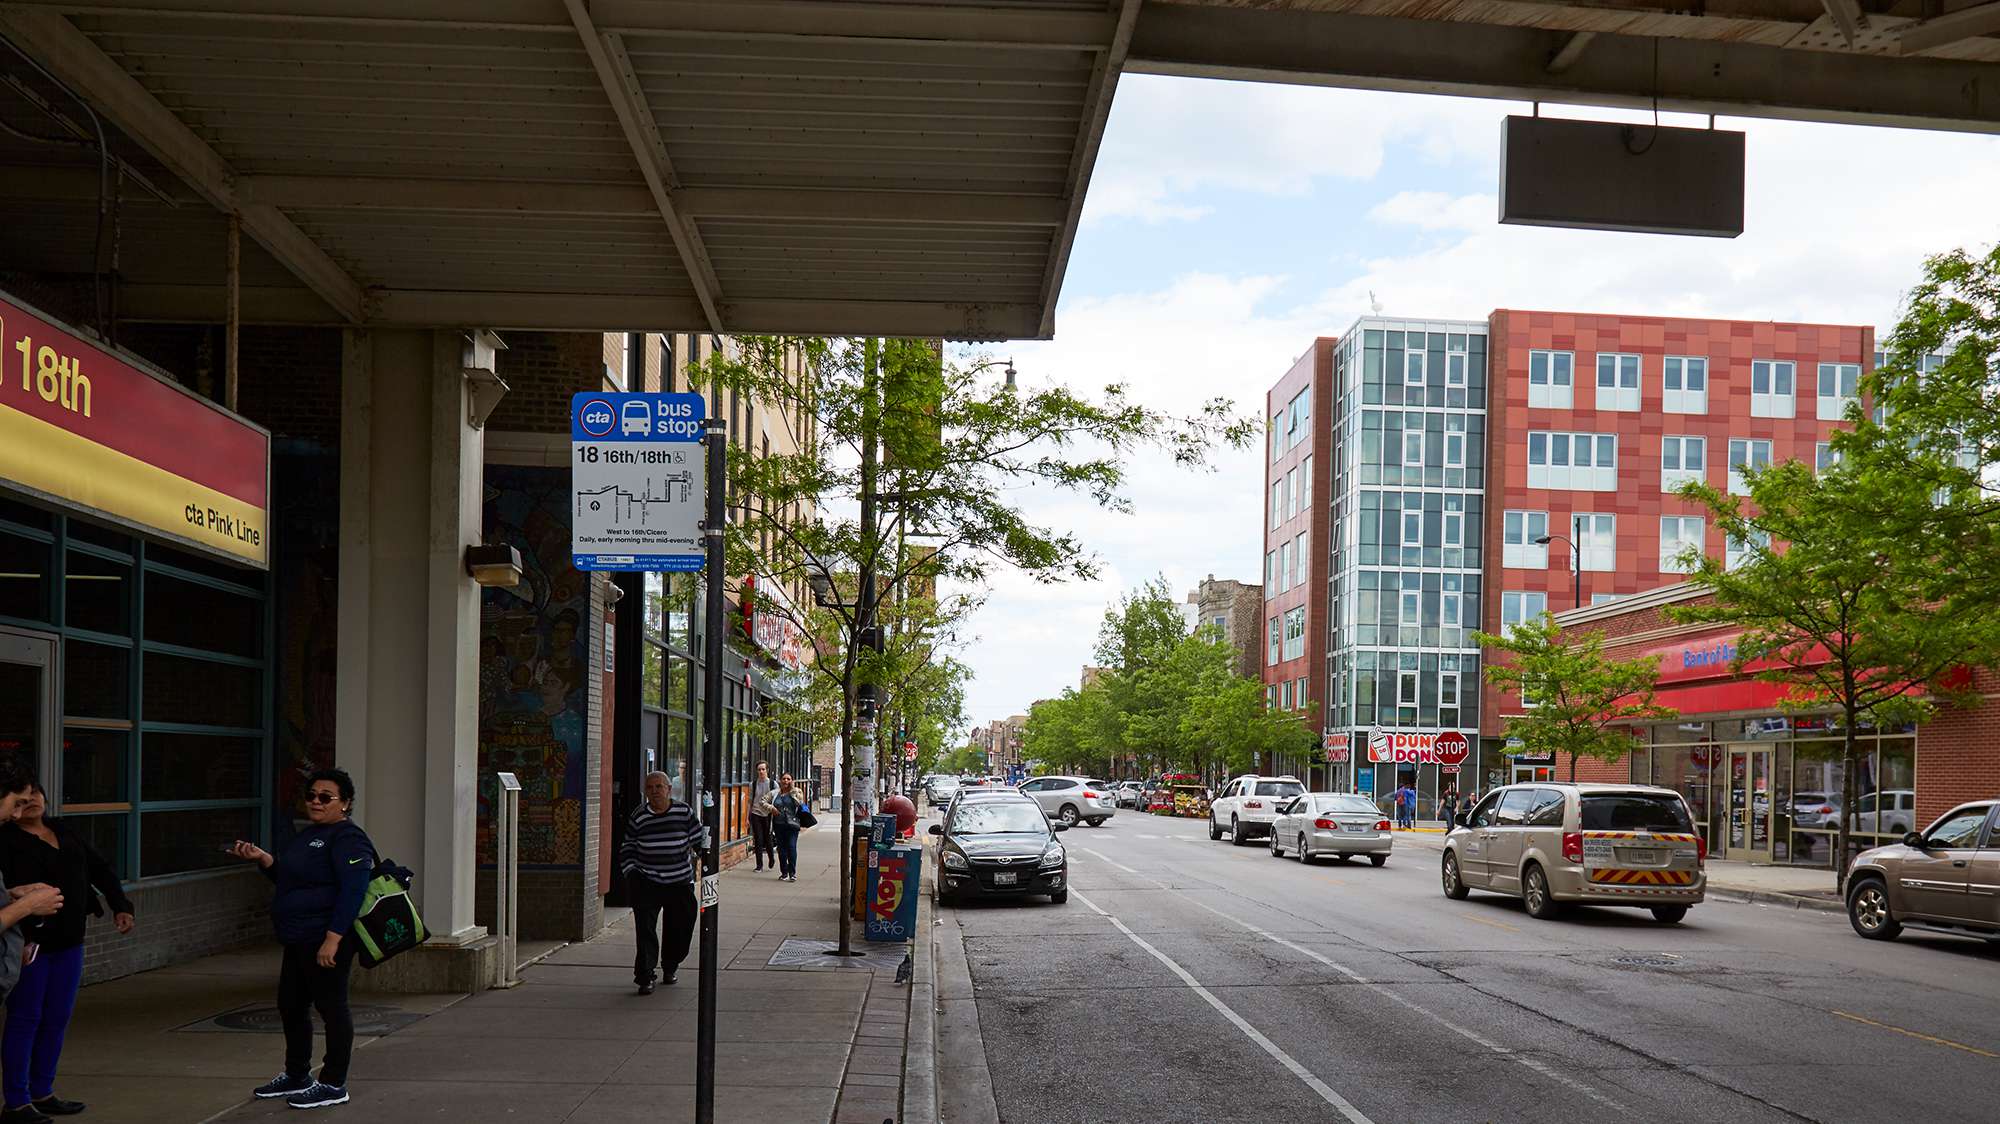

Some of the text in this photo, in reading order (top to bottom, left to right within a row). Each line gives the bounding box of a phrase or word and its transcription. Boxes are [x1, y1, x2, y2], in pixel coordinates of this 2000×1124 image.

[15, 335, 92, 418] 18th
[657, 400, 692, 417] bus
[585, 411, 610, 424] cta
[657, 419, 699, 438] stop
[577, 446, 672, 464] 18 16th/18th
[184, 503, 260, 546] cta Pink Line
[606, 528, 623, 536] West
[631, 528, 667, 536] 16th/Cicero
[579, 536, 597, 544] Daily,
[614, 537, 641, 545] morning
[655, 537, 695, 545] mid-evening
[1684, 648, 1709, 668] Bank
[1710, 643, 1721, 664] of
[1395, 734, 1437, 748] DUN
[1436, 741, 1466, 755] STOP
